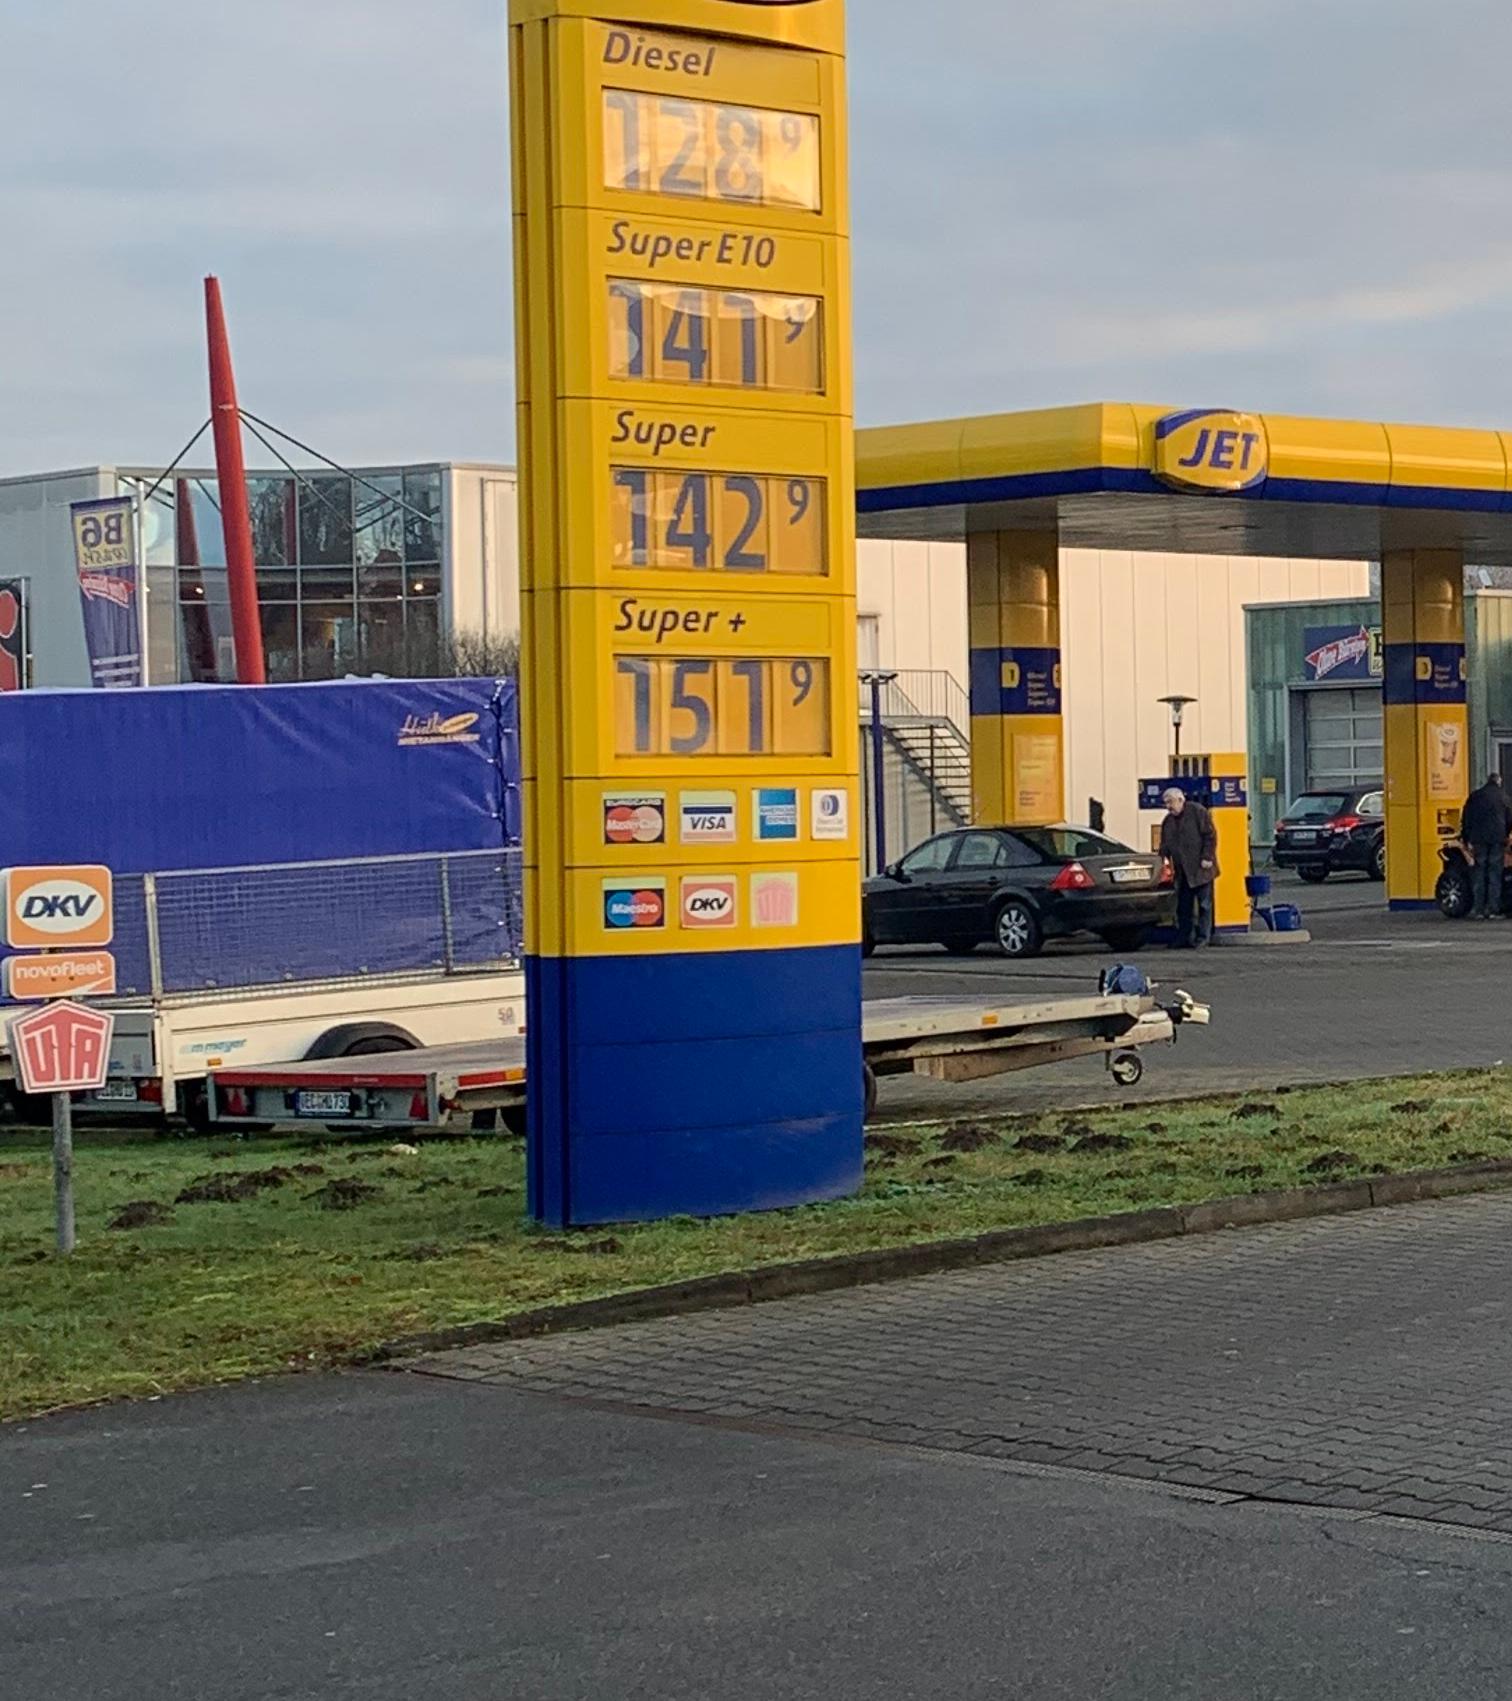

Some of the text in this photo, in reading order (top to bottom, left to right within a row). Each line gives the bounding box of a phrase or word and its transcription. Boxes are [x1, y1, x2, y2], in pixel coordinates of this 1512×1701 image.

[602, 31, 716, 77] Diesel
[606, 221, 777, 269] Super E10
[609, 283, 758, 386] 141
[611, 410, 716, 456] Super
[1178, 428, 1260, 470] JET
[613, 470, 809, 571] 142 9
[614, 599, 746, 643] Super +
[617, 660, 813, 753] 151 9
[690, 815, 727, 830] VISA
[22, 894, 98, 919] DKV
[611, 897, 659, 915] Maestro
[689, 897, 729, 912] DKV
[16, 960, 106, 980] novofleet
[23, 1006, 107, 1084] UTA
